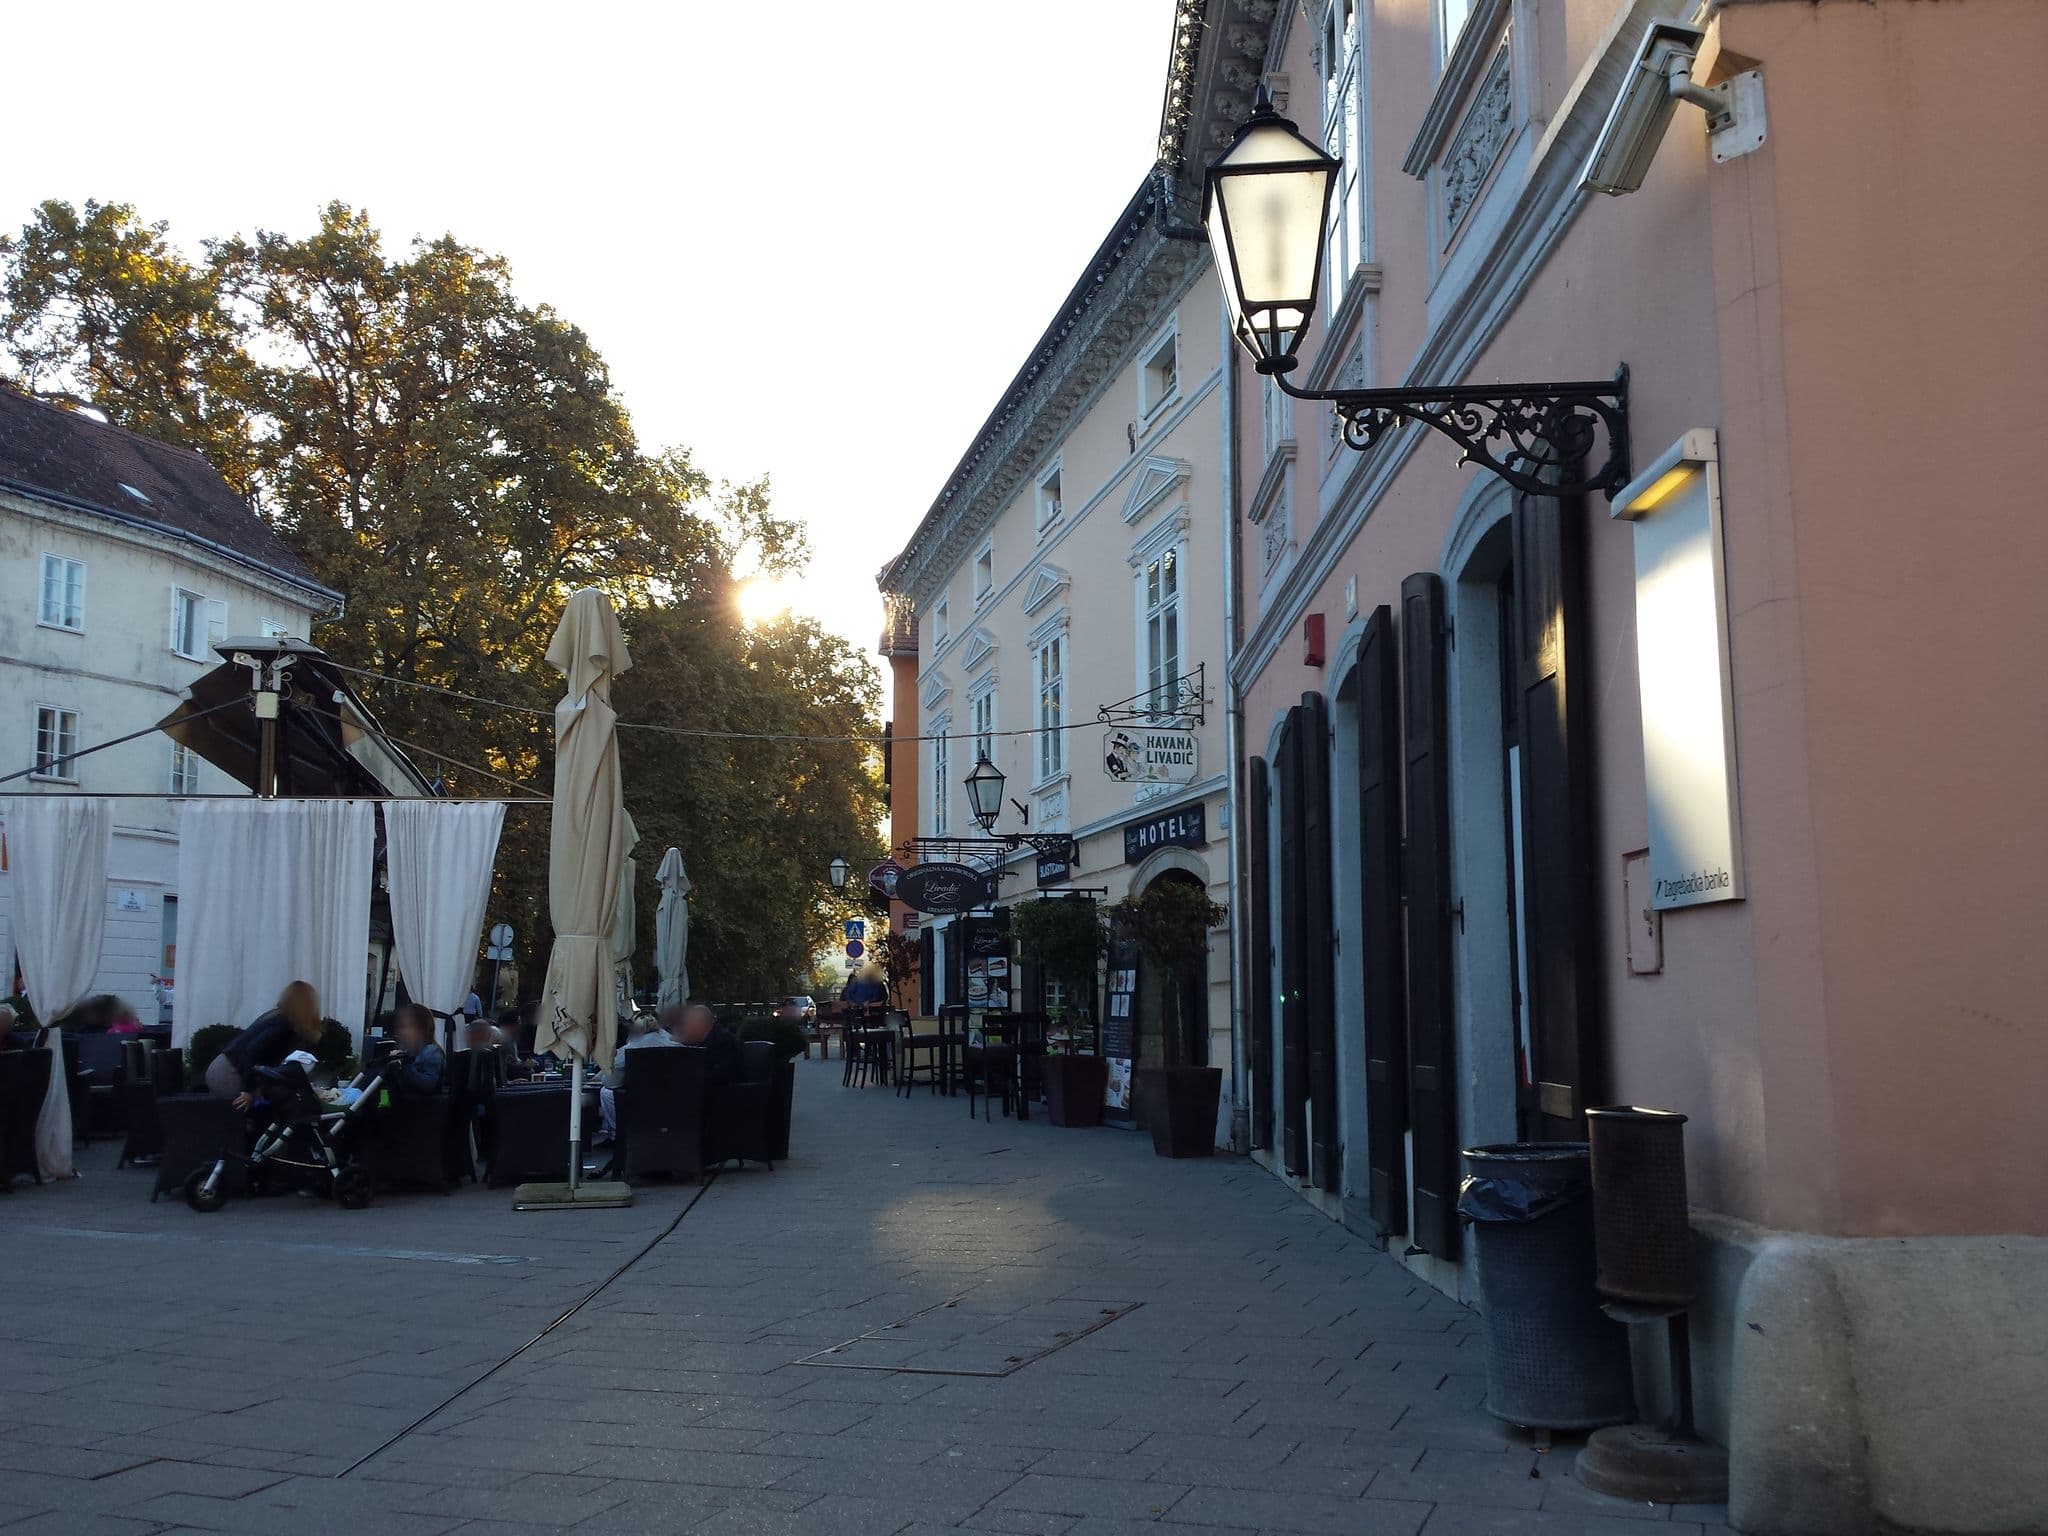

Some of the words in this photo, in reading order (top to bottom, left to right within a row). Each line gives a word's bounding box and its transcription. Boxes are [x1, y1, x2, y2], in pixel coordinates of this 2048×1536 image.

[1147, 751, 1193, 765] LIVADIĆ
[1139, 816, 1186, 847] HOTEL
[1663, 872, 1704, 901] Zagrebačka
[1704, 867, 1729, 890] banka
